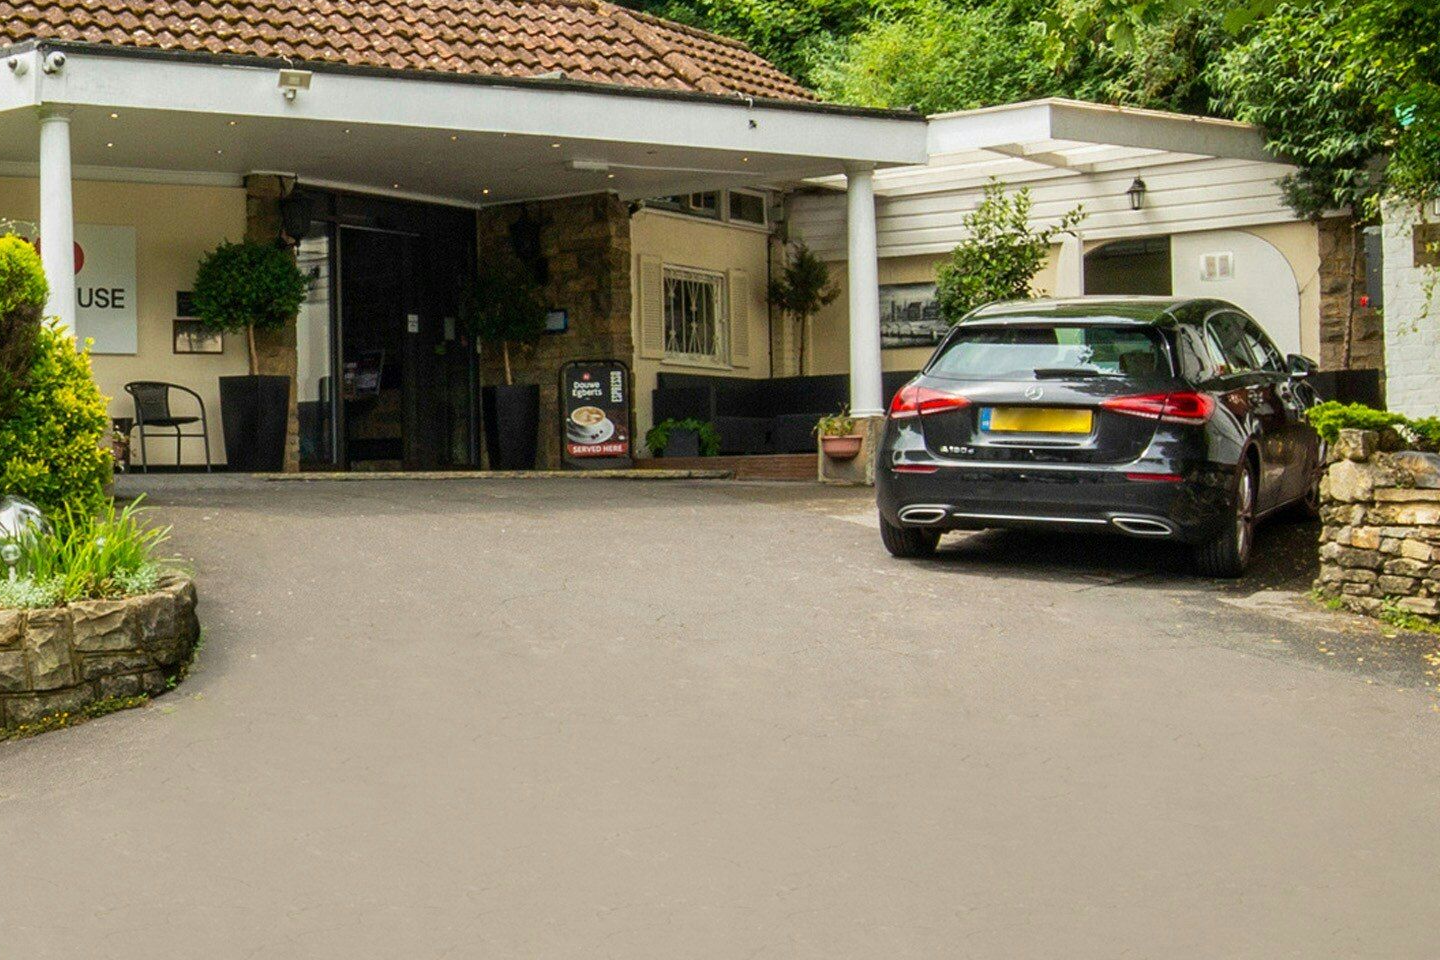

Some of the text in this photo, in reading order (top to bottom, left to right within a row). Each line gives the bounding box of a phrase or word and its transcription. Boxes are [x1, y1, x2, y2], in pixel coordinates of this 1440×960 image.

[77, 286, 124, 309] USE
[572, 389, 602, 398] Egberts
[572, 445, 602, 454] SERVED
